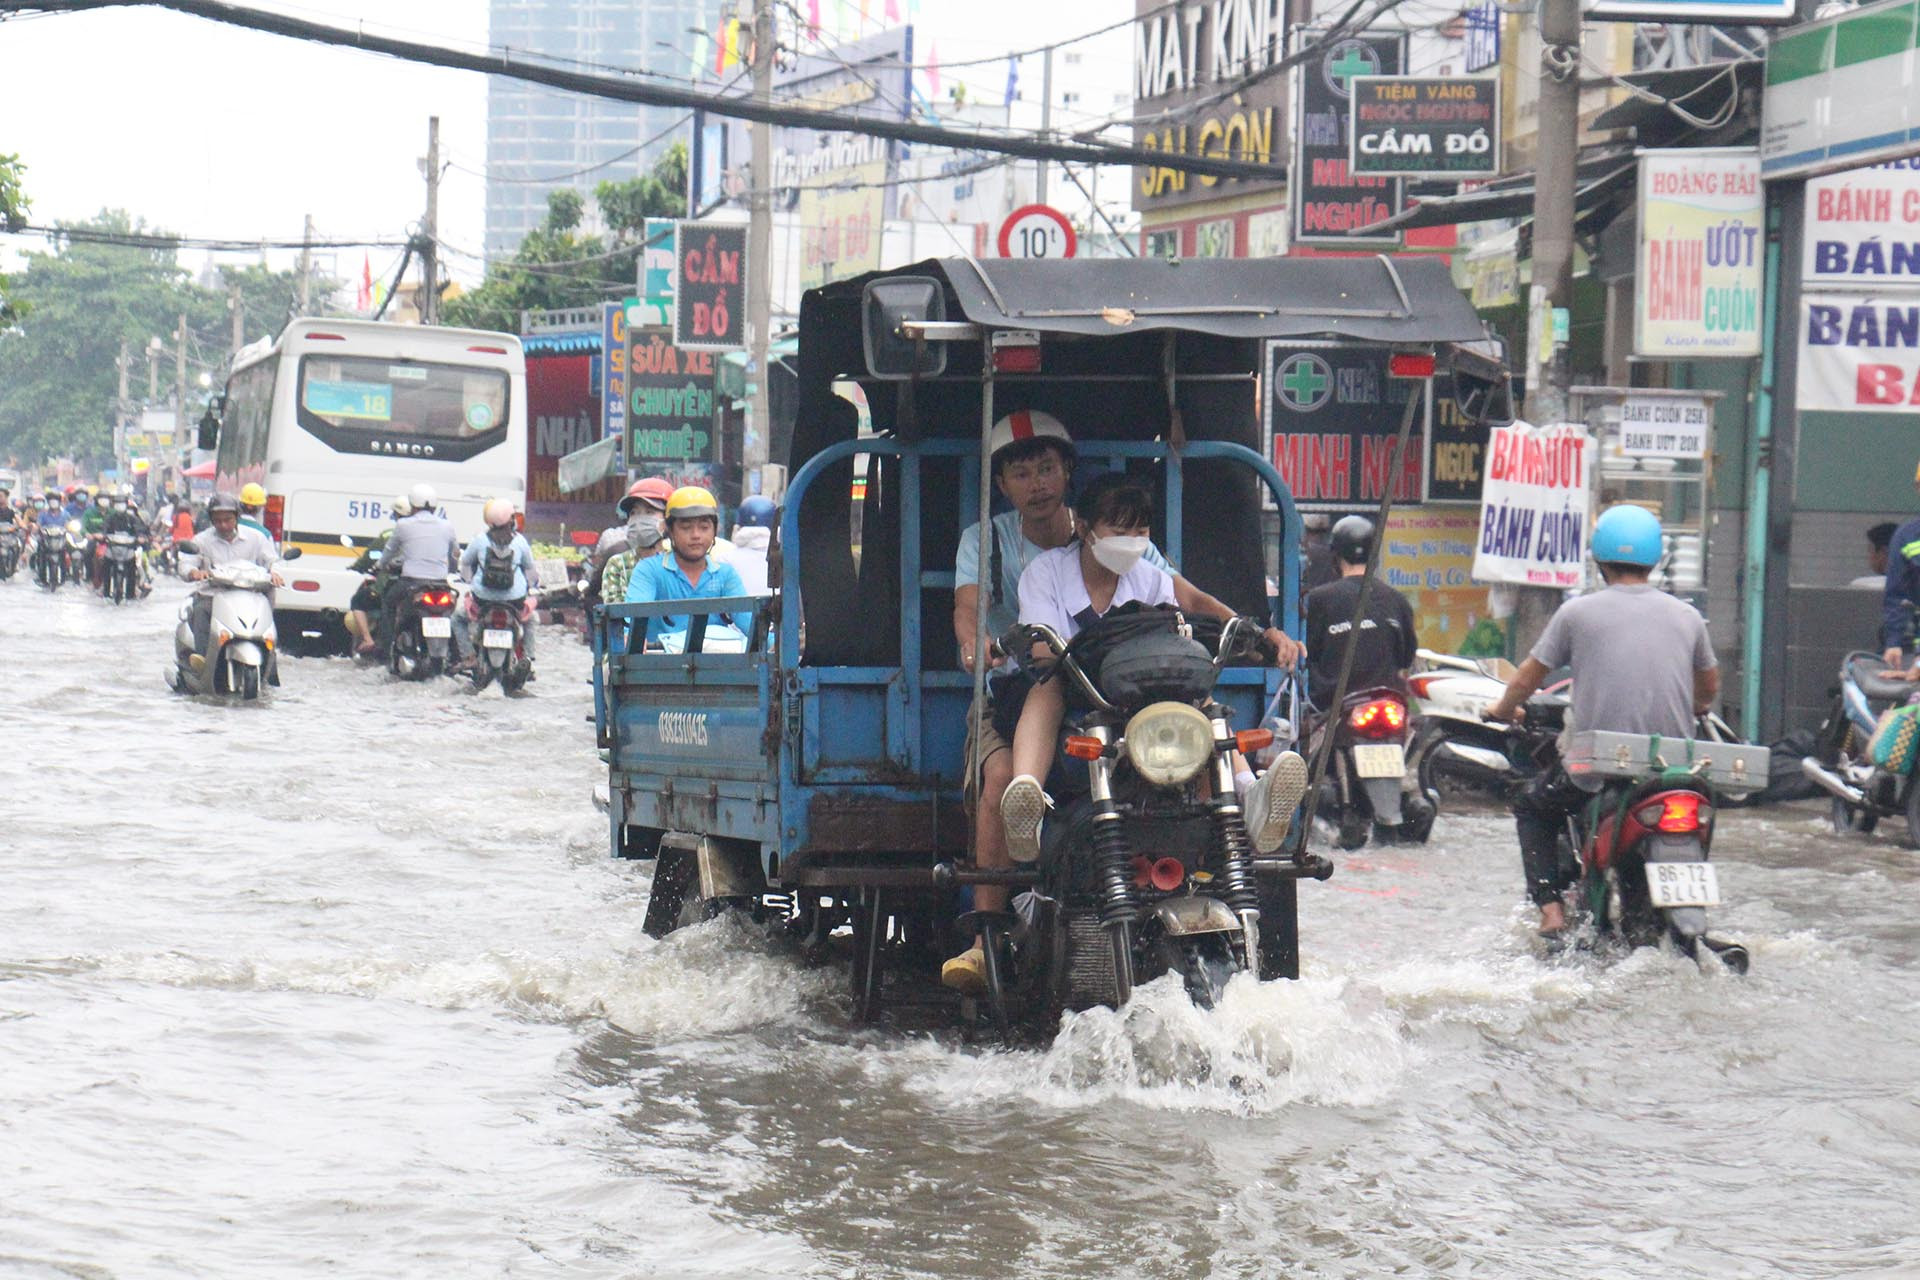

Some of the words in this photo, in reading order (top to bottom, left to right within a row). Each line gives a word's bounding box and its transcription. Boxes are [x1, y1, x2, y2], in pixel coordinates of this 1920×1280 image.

[1427, 82, 1476, 99] VÀNG
[1445, 127, 1490, 154] ĐỒ
[1817, 183, 1891, 224] BÁNH
[1649, 224, 1704, 321] BÁNH
[692, 287, 729, 337] ĐỒ
[632, 335, 679, 375] SỬA
[631, 381, 713, 418] CHUYÊN
[370, 440, 435, 456] SAMCO
[633, 423, 708, 462] NGHIỆP
[1482, 497, 1535, 560] BÁNH
